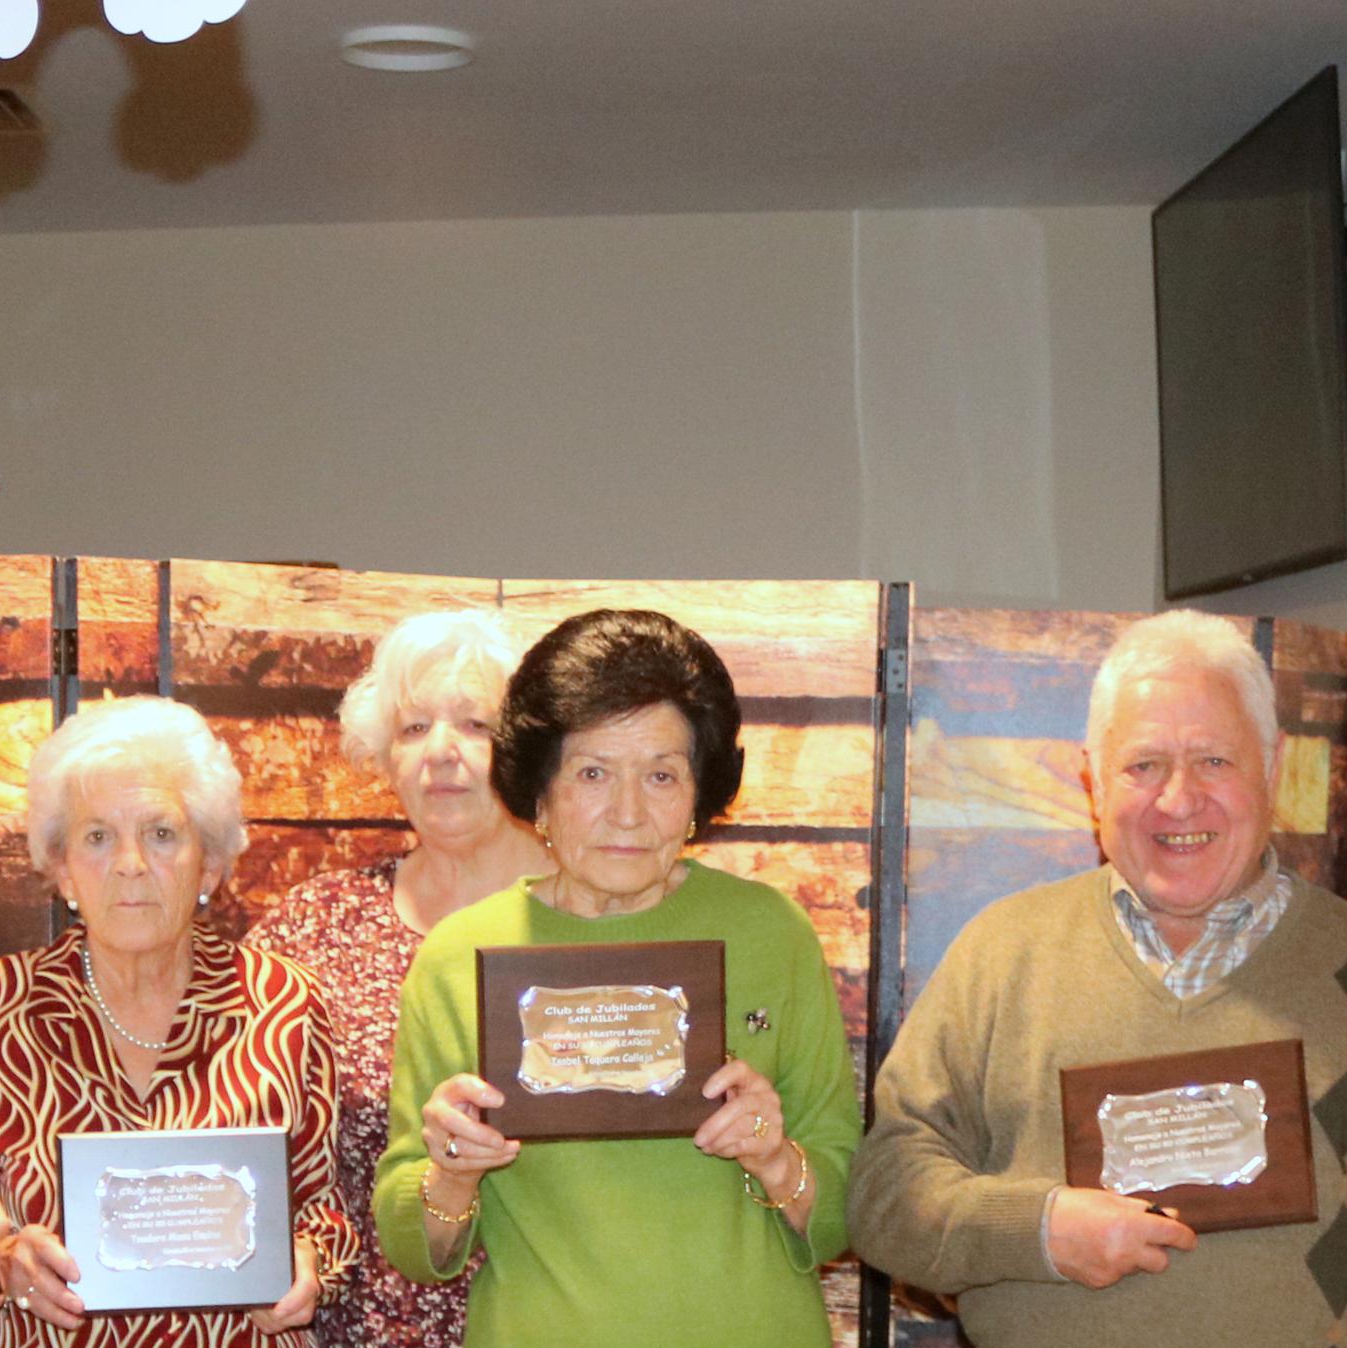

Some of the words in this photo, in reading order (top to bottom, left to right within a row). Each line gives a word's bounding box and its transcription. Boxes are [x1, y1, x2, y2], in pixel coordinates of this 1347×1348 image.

[544, 1006, 572, 1015] Club
[576, 1005, 591, 1014] de
[595, 1003, 656, 1014] Jubilados
[568, 1015, 588, 1024] SAN
[590, 1012, 628, 1023] MILLÁN
[552, 1056, 580, 1066] Isabel
